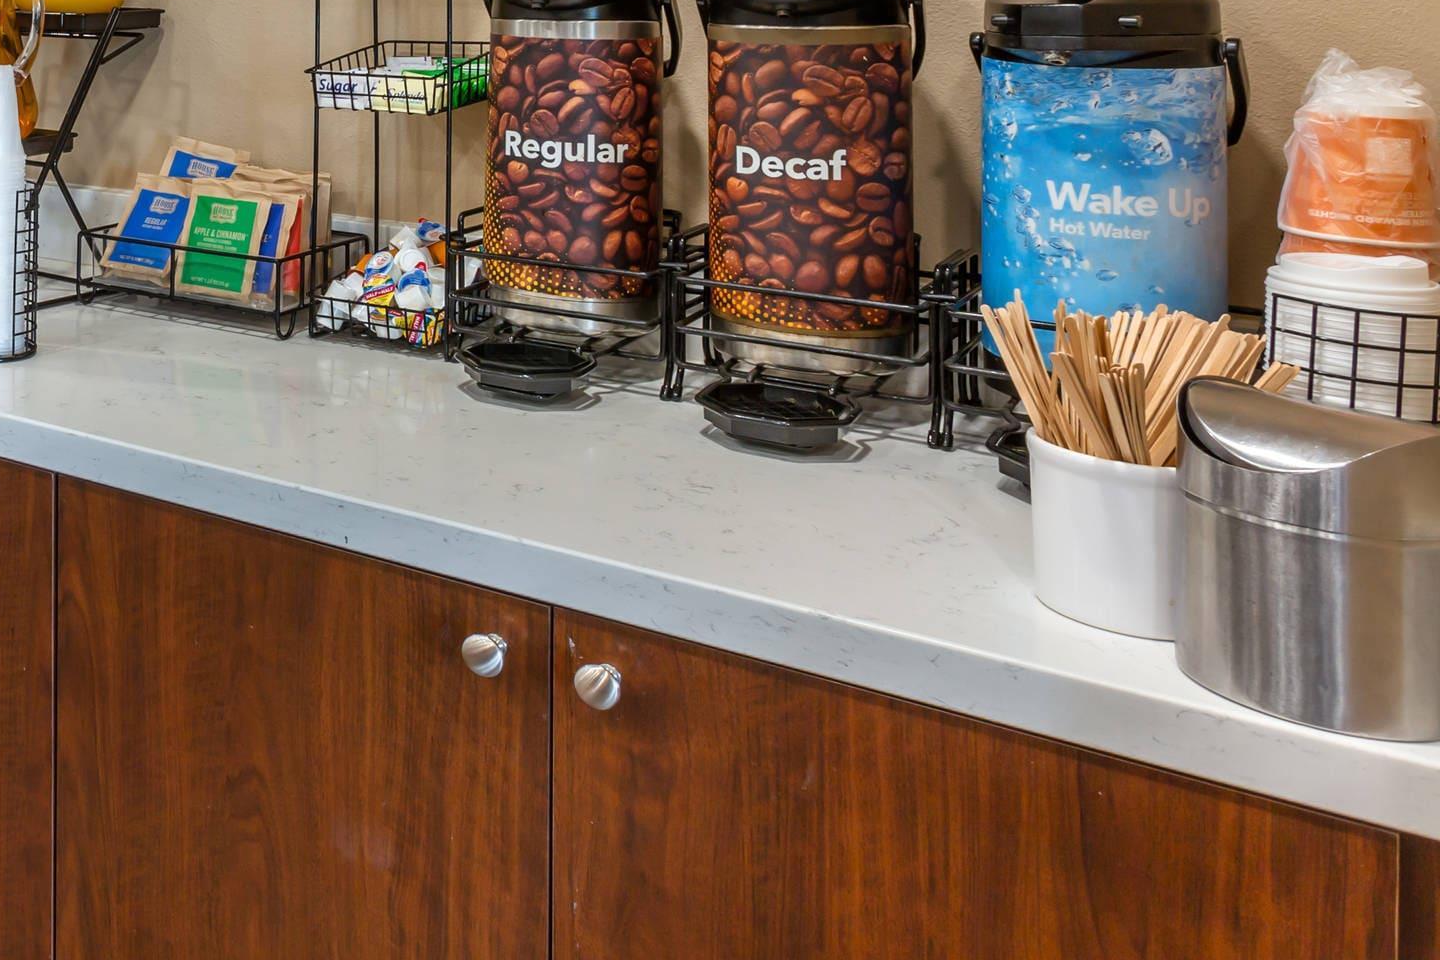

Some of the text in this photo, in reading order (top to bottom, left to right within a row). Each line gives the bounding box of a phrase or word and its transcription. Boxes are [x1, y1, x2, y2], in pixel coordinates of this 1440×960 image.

[319, 78, 358, 93] Sugar
[504, 129, 629, 168] Regular
[735, 145, 847, 181] Decaf
[1045, 179, 1211, 225] Wake Up
[193, 226, 210, 237] APPLE
[216, 229, 246, 241] CINNAMON
[1049, 216, 1151, 240] Hot Water
